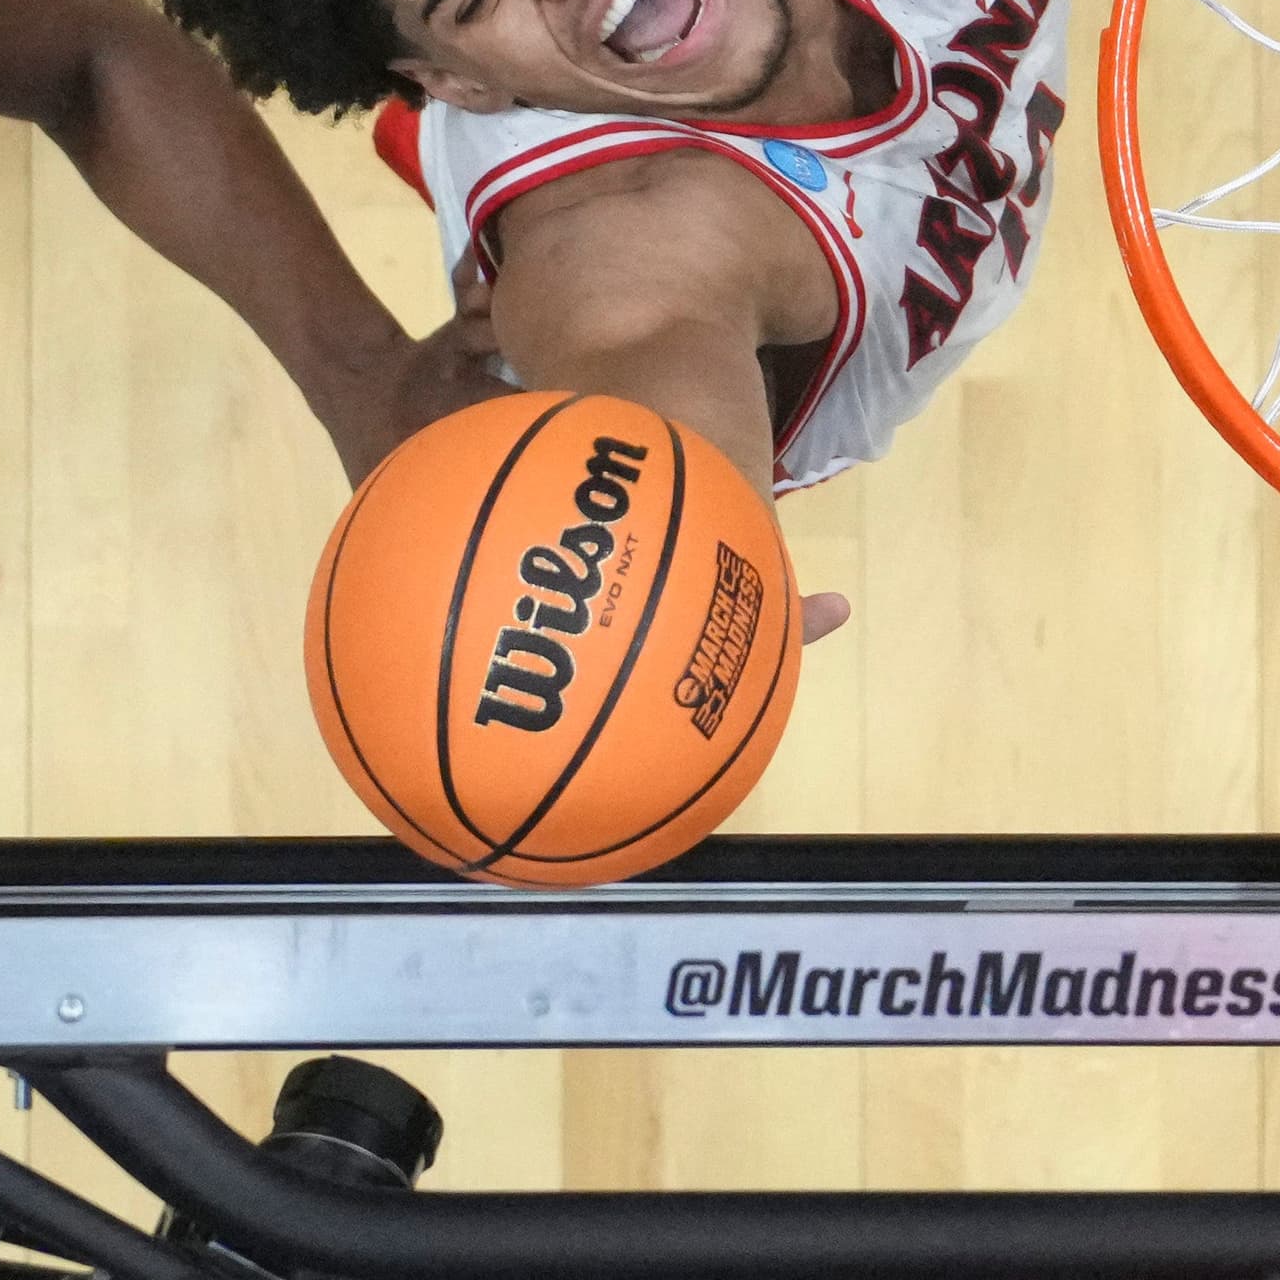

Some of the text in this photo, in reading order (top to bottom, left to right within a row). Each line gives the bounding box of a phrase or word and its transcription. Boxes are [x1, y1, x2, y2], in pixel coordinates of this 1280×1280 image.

[474, 435, 649, 733] Wilson
[598, 532, 640, 629] EVO NXT
[718, 566, 760, 686] MADNESS
[690, 591, 734, 683] MARCH
